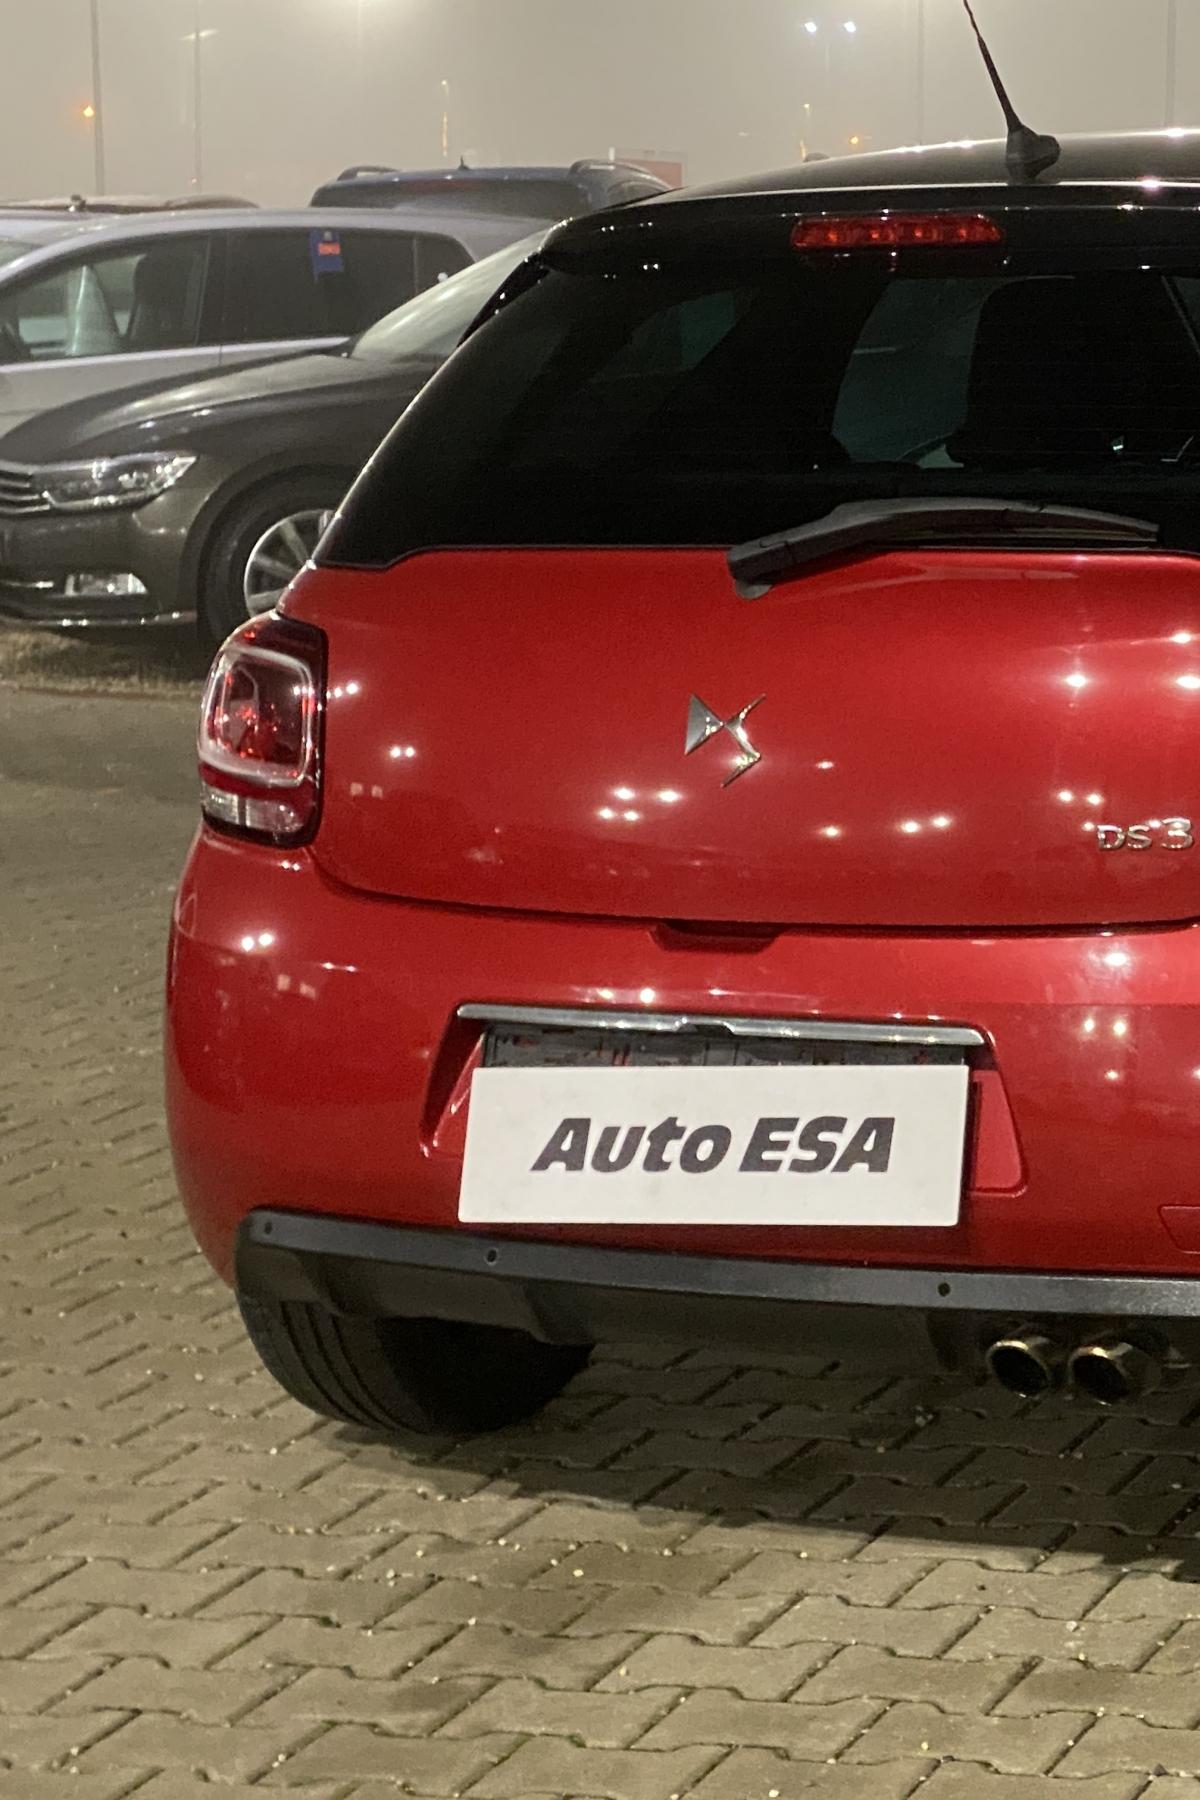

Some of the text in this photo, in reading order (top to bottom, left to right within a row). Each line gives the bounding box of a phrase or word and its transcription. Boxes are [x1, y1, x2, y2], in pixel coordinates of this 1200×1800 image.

[1097, 817, 1193, 850] DS 3
[530, 1116, 896, 1173] Auto ESA
